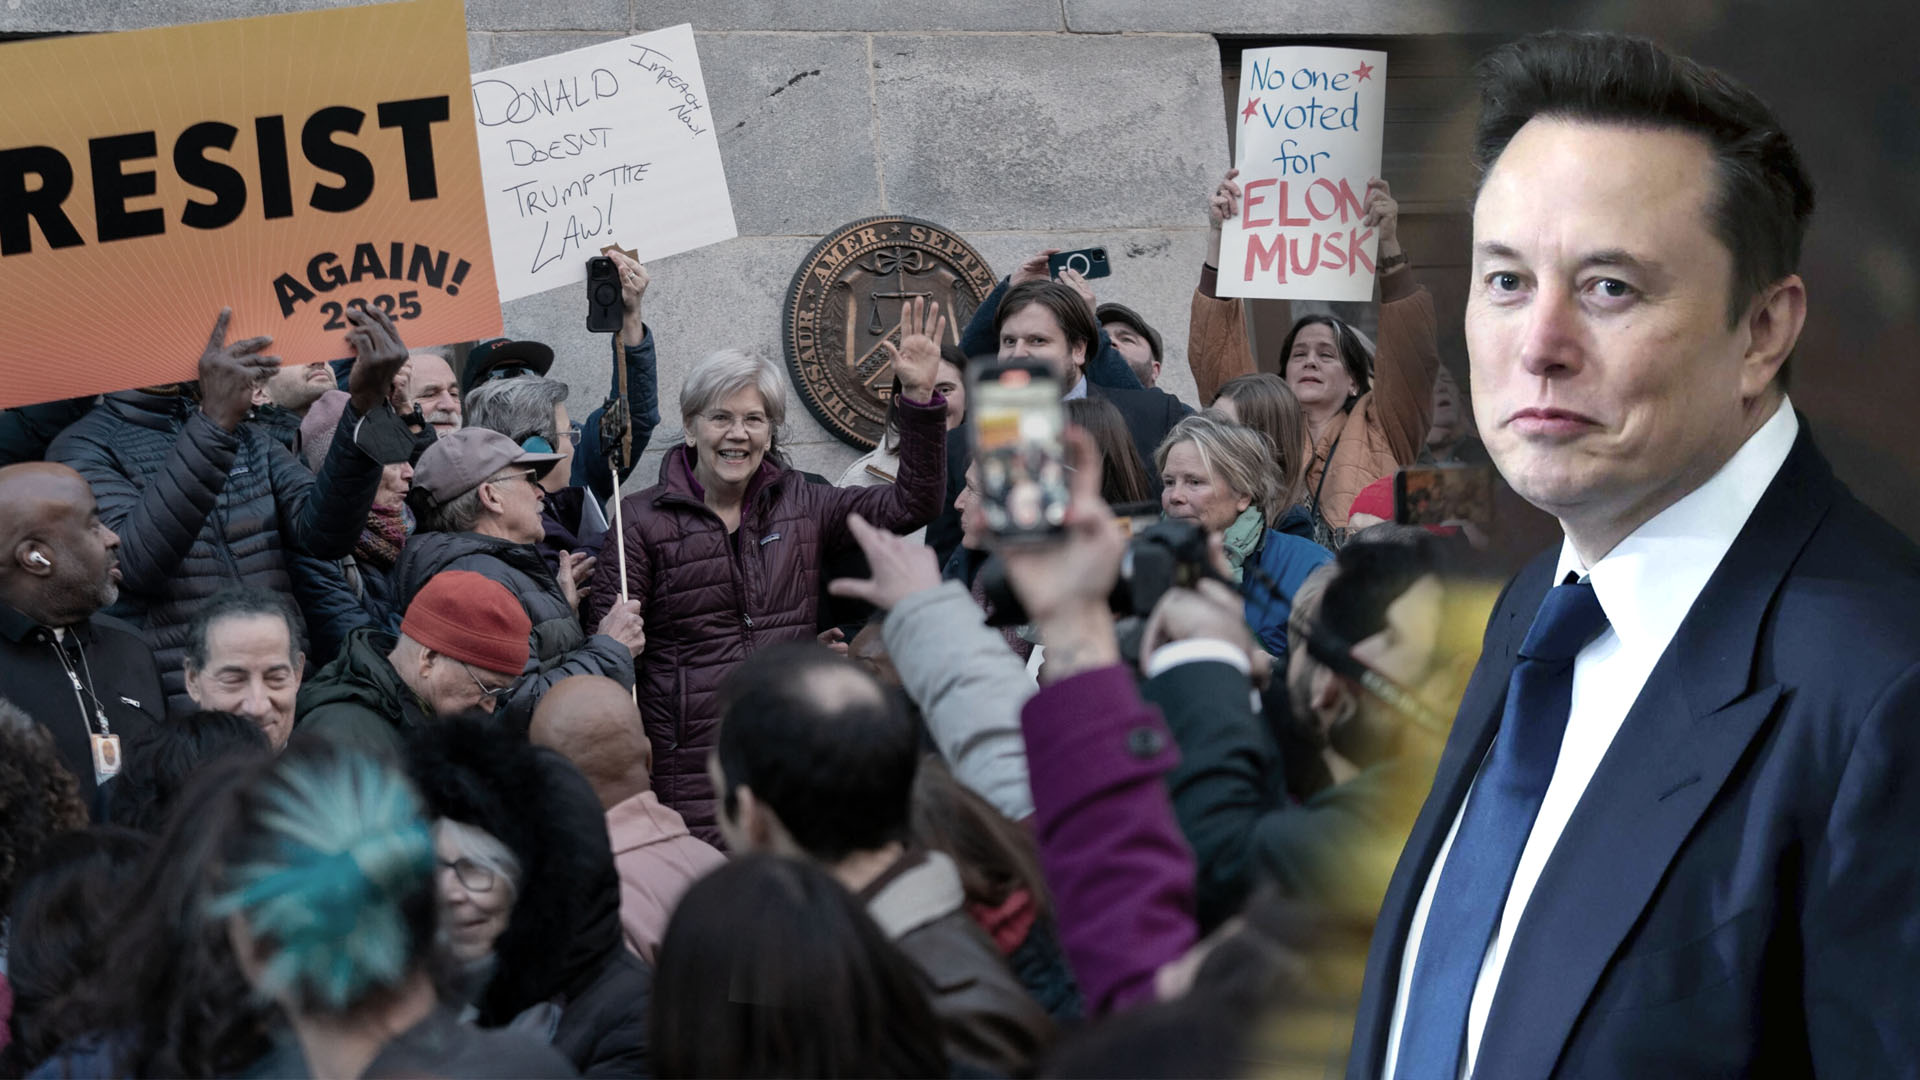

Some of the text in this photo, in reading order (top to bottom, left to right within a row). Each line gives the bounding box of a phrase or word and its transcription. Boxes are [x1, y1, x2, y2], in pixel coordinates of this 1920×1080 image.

[472, 68, 619, 126] DONALD
[1250, 57, 1351, 91] No one
[1263, 91, 1359, 132] voted
[0, 95, 450, 257] RESIST
[1272, 139, 1330, 176] for
[502, 162, 653, 218] TRUMP THE
[1242, 176, 1374, 230] ELON
[531, 193, 614, 274] LAW!
[814, 228, 888, 287] AMER.
[1244, 227, 1376, 284] MUSK
[272, 241, 472, 319] AGAIN!
